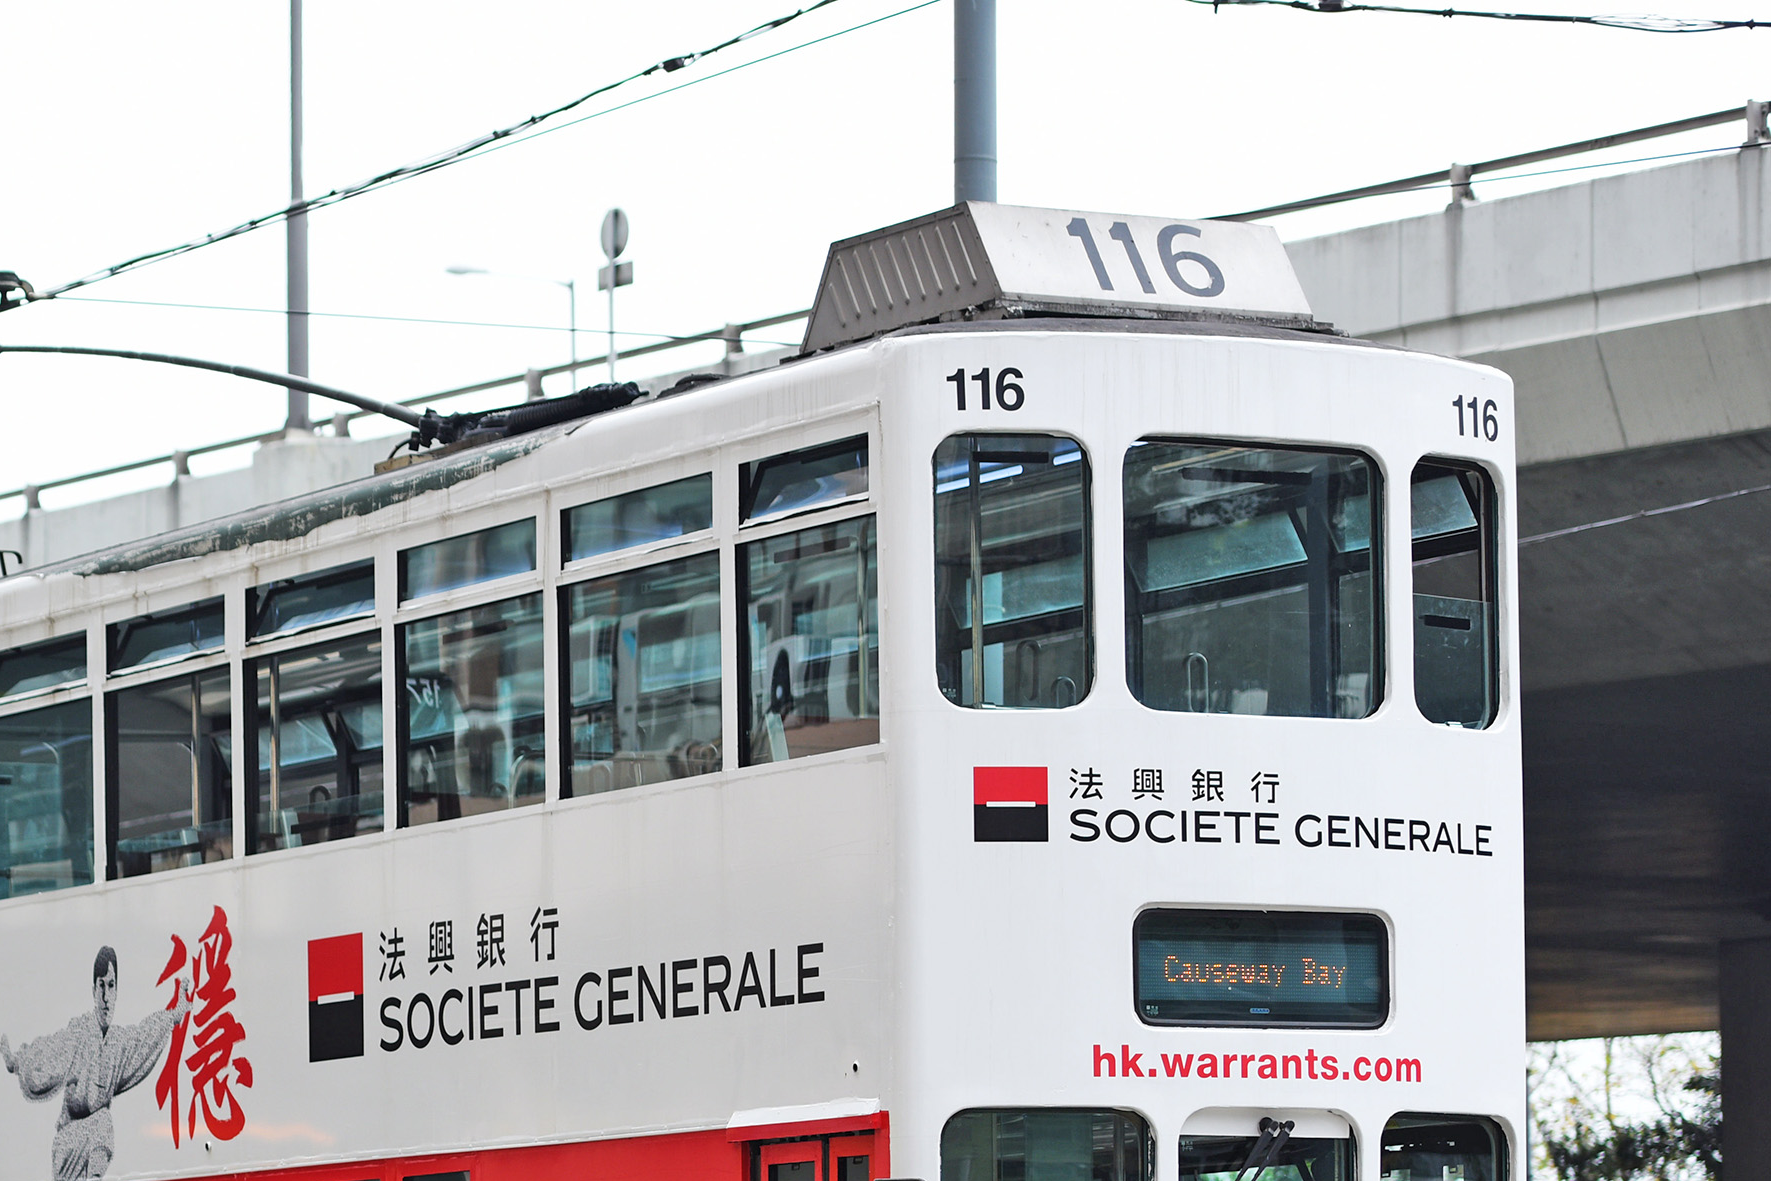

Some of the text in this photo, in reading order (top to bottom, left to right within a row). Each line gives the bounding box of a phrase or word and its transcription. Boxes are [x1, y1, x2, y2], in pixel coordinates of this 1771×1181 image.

[1066, 217, 1226, 298] 116
[946, 367, 1026, 412] 116
[1452, 394, 1500, 442] 116
[1068, 766, 1281, 804] 法興銀行
[1069, 808, 1494, 858] SOCIETE GENERALE
[378, 905, 561, 983] 法興銀行
[1163, 955, 1348, 989] Causeway Bay
[379, 942, 827, 1053] SOCIETE GENERALE
[1091, 1043, 1423, 1083] hk.warrants.com
